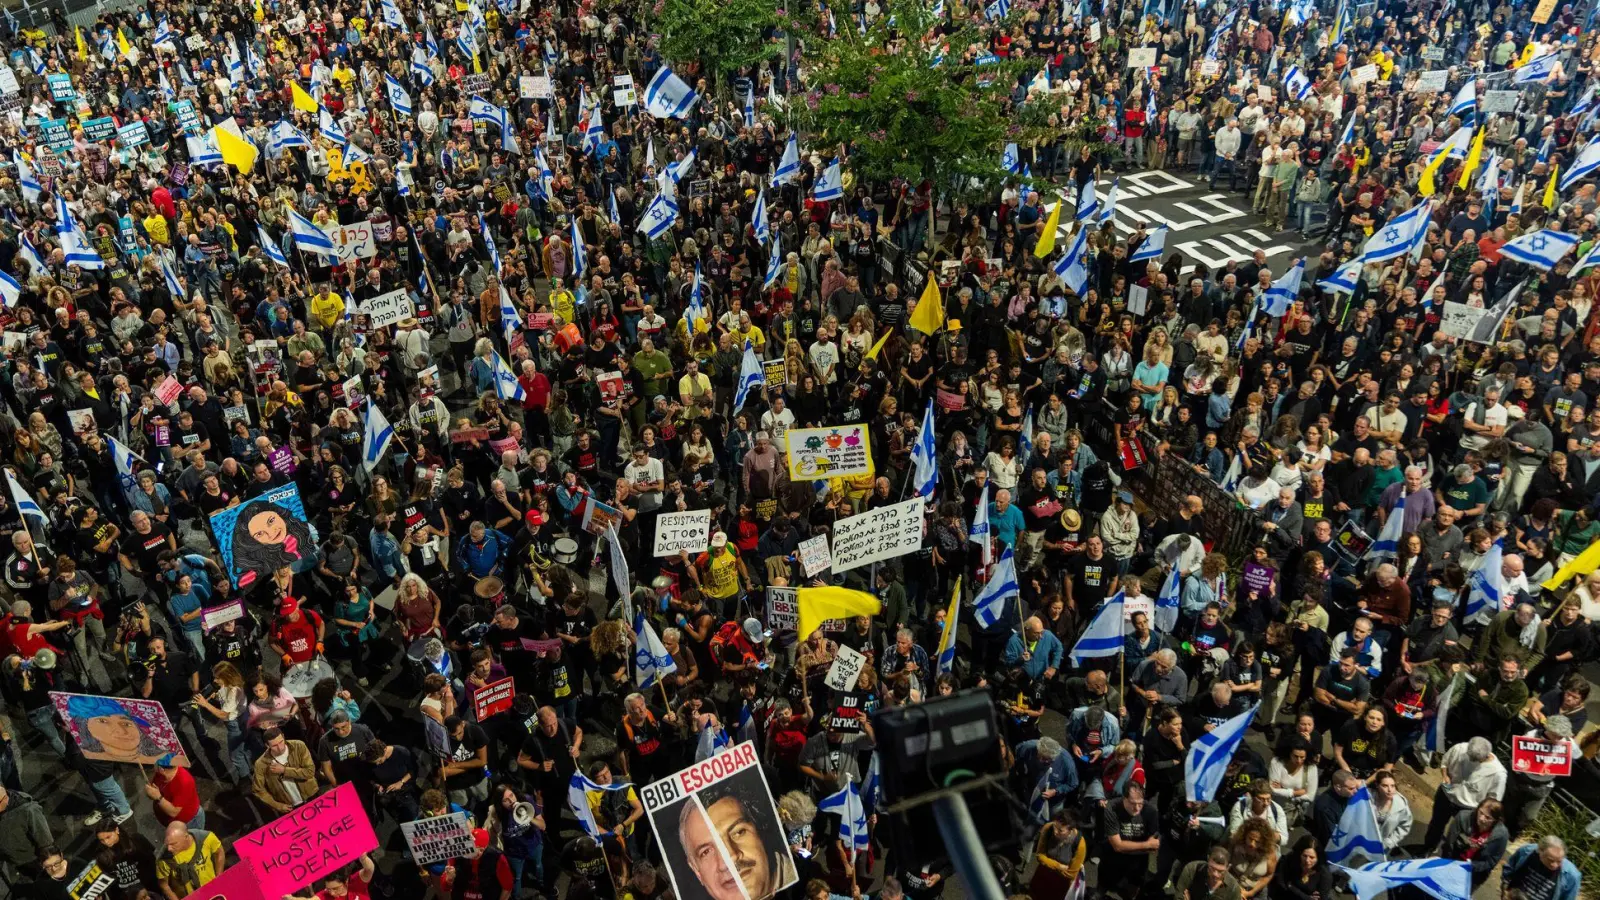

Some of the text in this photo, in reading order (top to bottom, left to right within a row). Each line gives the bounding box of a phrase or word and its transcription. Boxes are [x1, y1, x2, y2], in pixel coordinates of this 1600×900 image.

[394, 293, 405, 306] אין
[399, 304, 409, 316] על
[660, 514, 710, 528] RESISTANCE
[871, 508, 897, 523] הקריב
[903, 516, 919, 526] כדי
[853, 517, 867, 530] את
[879, 519, 901, 533] להציל
[904, 525, 920, 535] ביבי
[833, 523, 851, 539] עצמו
[864, 527, 877, 537] את
[878, 530, 901, 542] מקריב
[657, 537, 708, 553] DICTATORSHIP
[800, 536, 825, 550] LIVES
[833, 531, 864, 551] החטופים
[864, 537, 876, 547] את
[836, 542, 864, 558] החטופים
[838, 536, 918, 566] כדי להציל את עצמו
[804, 551, 828, 566] DEALS
[850, 653, 859, 663] די
[837, 665, 854, 678] STOP
[831, 677, 847, 691] WAR
[838, 674, 848, 683] THE
[476, 681, 511, 700] ISRAELIS CHOOSE
[479, 699, 487, 708] THE
[843, 696, 858, 707] עם
[832, 718, 859, 729] בארצו
[1551, 743, 1567, 754] את
[1535, 754, 1566, 765] עכשיו
[643, 743, 756, 809] BIBI ESCOBAR
[248, 791, 339, 847] VICTORY
[262, 813, 356, 873] HOSTAGE
[453, 834, 471, 844] את
[290, 844, 348, 882] DEAL
